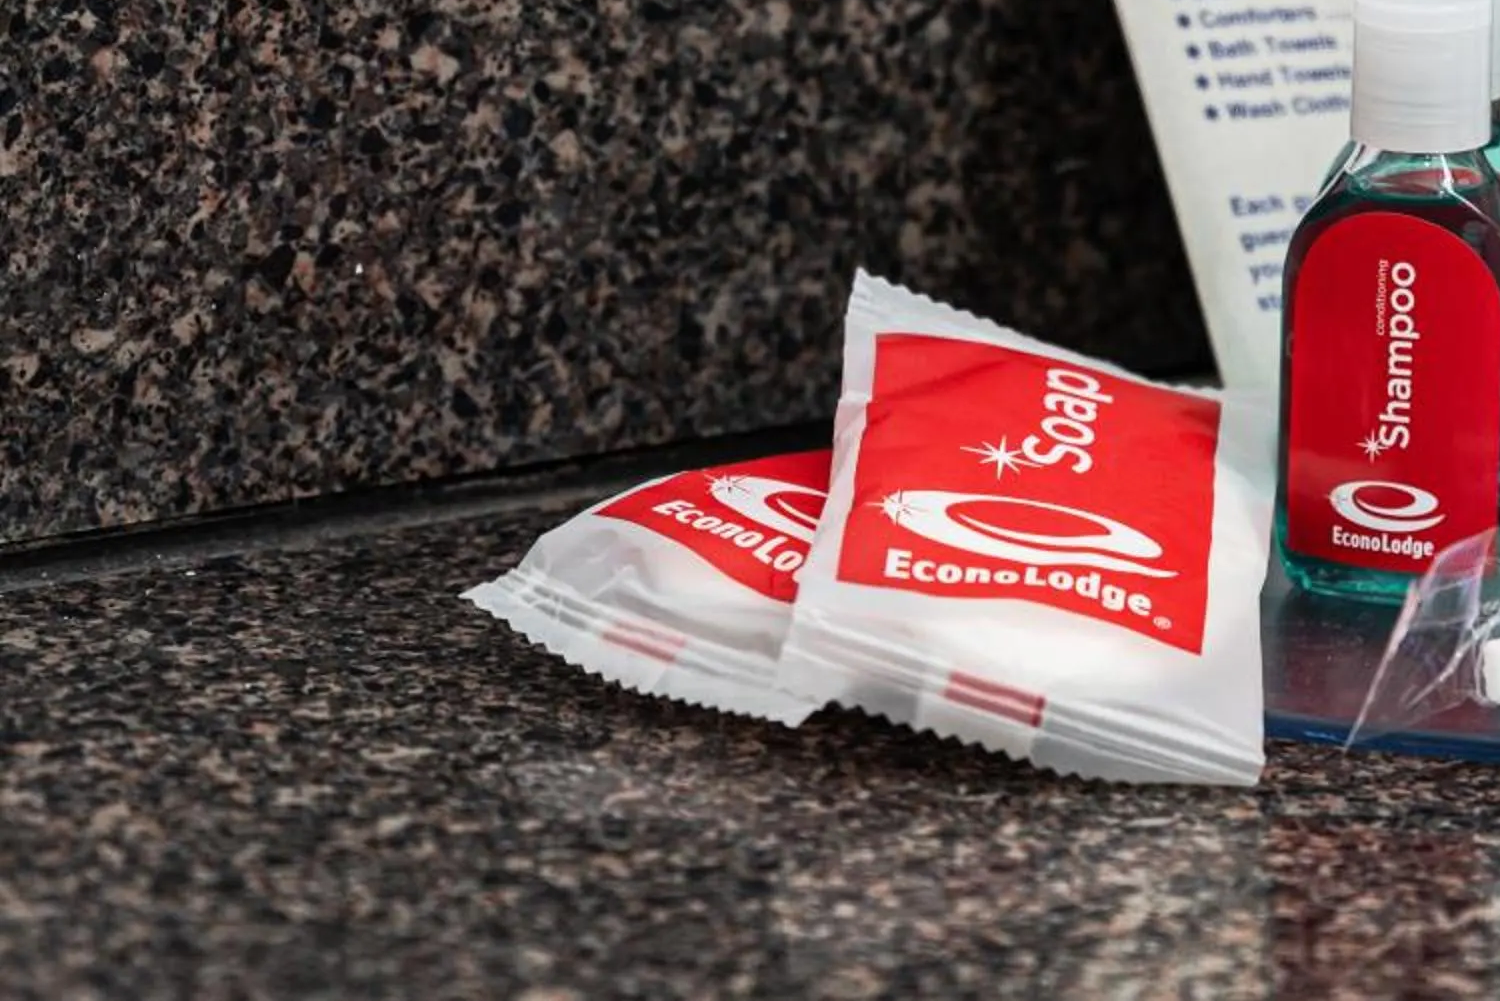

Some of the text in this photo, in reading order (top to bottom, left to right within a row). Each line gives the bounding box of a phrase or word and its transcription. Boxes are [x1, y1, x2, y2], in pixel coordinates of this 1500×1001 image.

[1199, 6, 1317, 28] Comforters
[1207, 35, 1336, 59] Bath Towels
[1217, 69, 1274, 89] Hand
[1226, 95, 1350, 119] Wash Cloth
[1376, 259, 1389, 336] conditioning
[1379, 261, 1420, 448] Shampoo
[1021, 368, 1114, 474] Soap
[1332, 525, 1435, 559] EconoLodge
[884, 548, 1153, 617] EconoLodge
